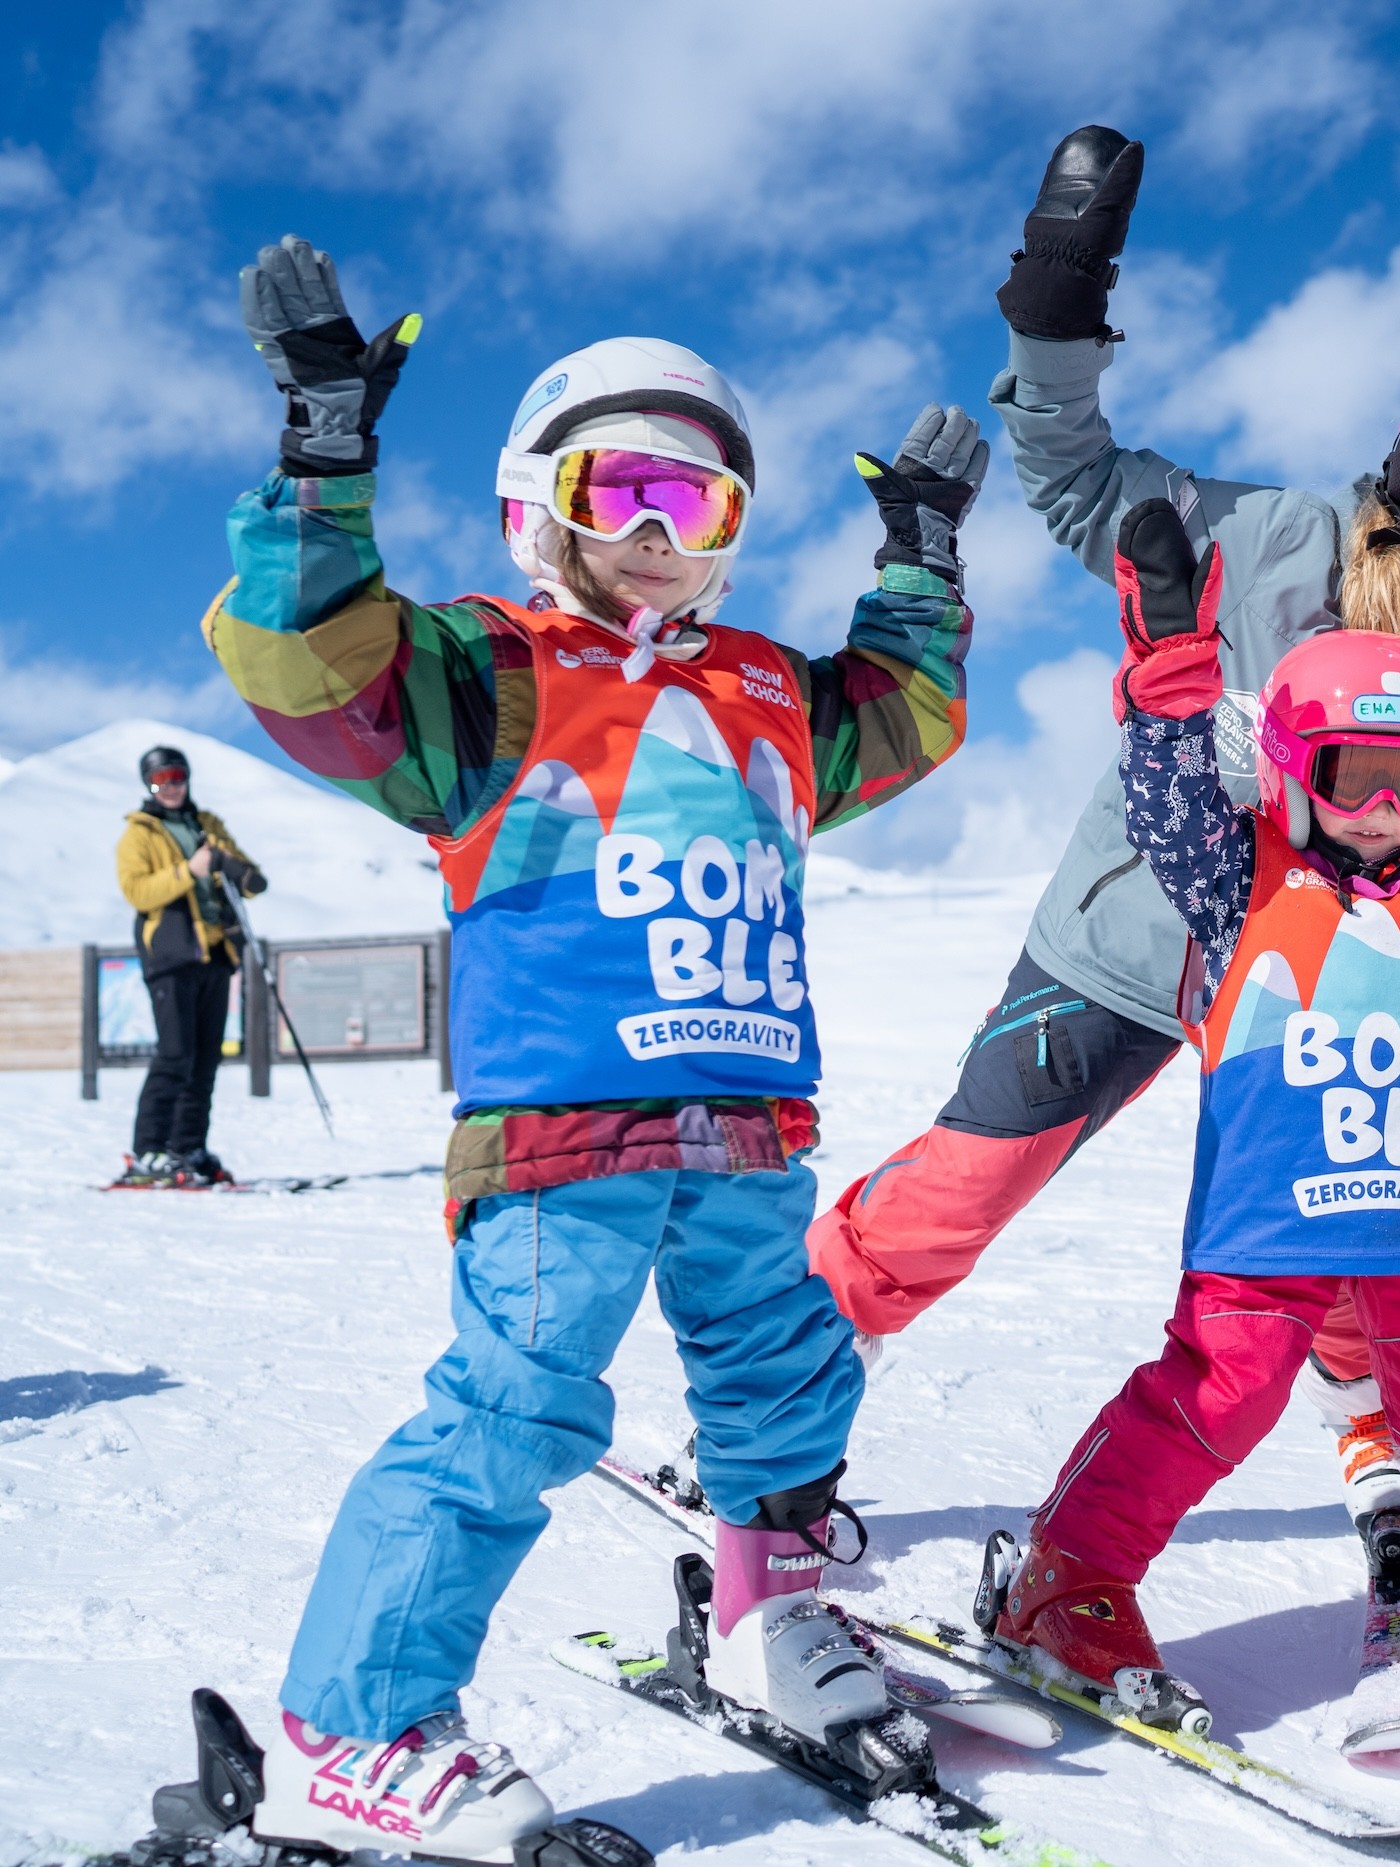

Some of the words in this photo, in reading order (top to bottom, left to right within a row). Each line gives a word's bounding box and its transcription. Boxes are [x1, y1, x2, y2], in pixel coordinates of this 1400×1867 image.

[740, 663, 783, 689] SNOW
[742, 679, 798, 710] SCHOOL
[1219, 702, 1243, 728] ZERO
[1214, 737, 1242, 765] RIDERS
[595, 833, 786, 928] BOM
[1306, 871, 1323, 880] ZER
[646, 917, 805, 1012] BLE
[634, 1018, 796, 1052] ZEROGRAVITY
[308, 1782, 422, 1842] LANGE
